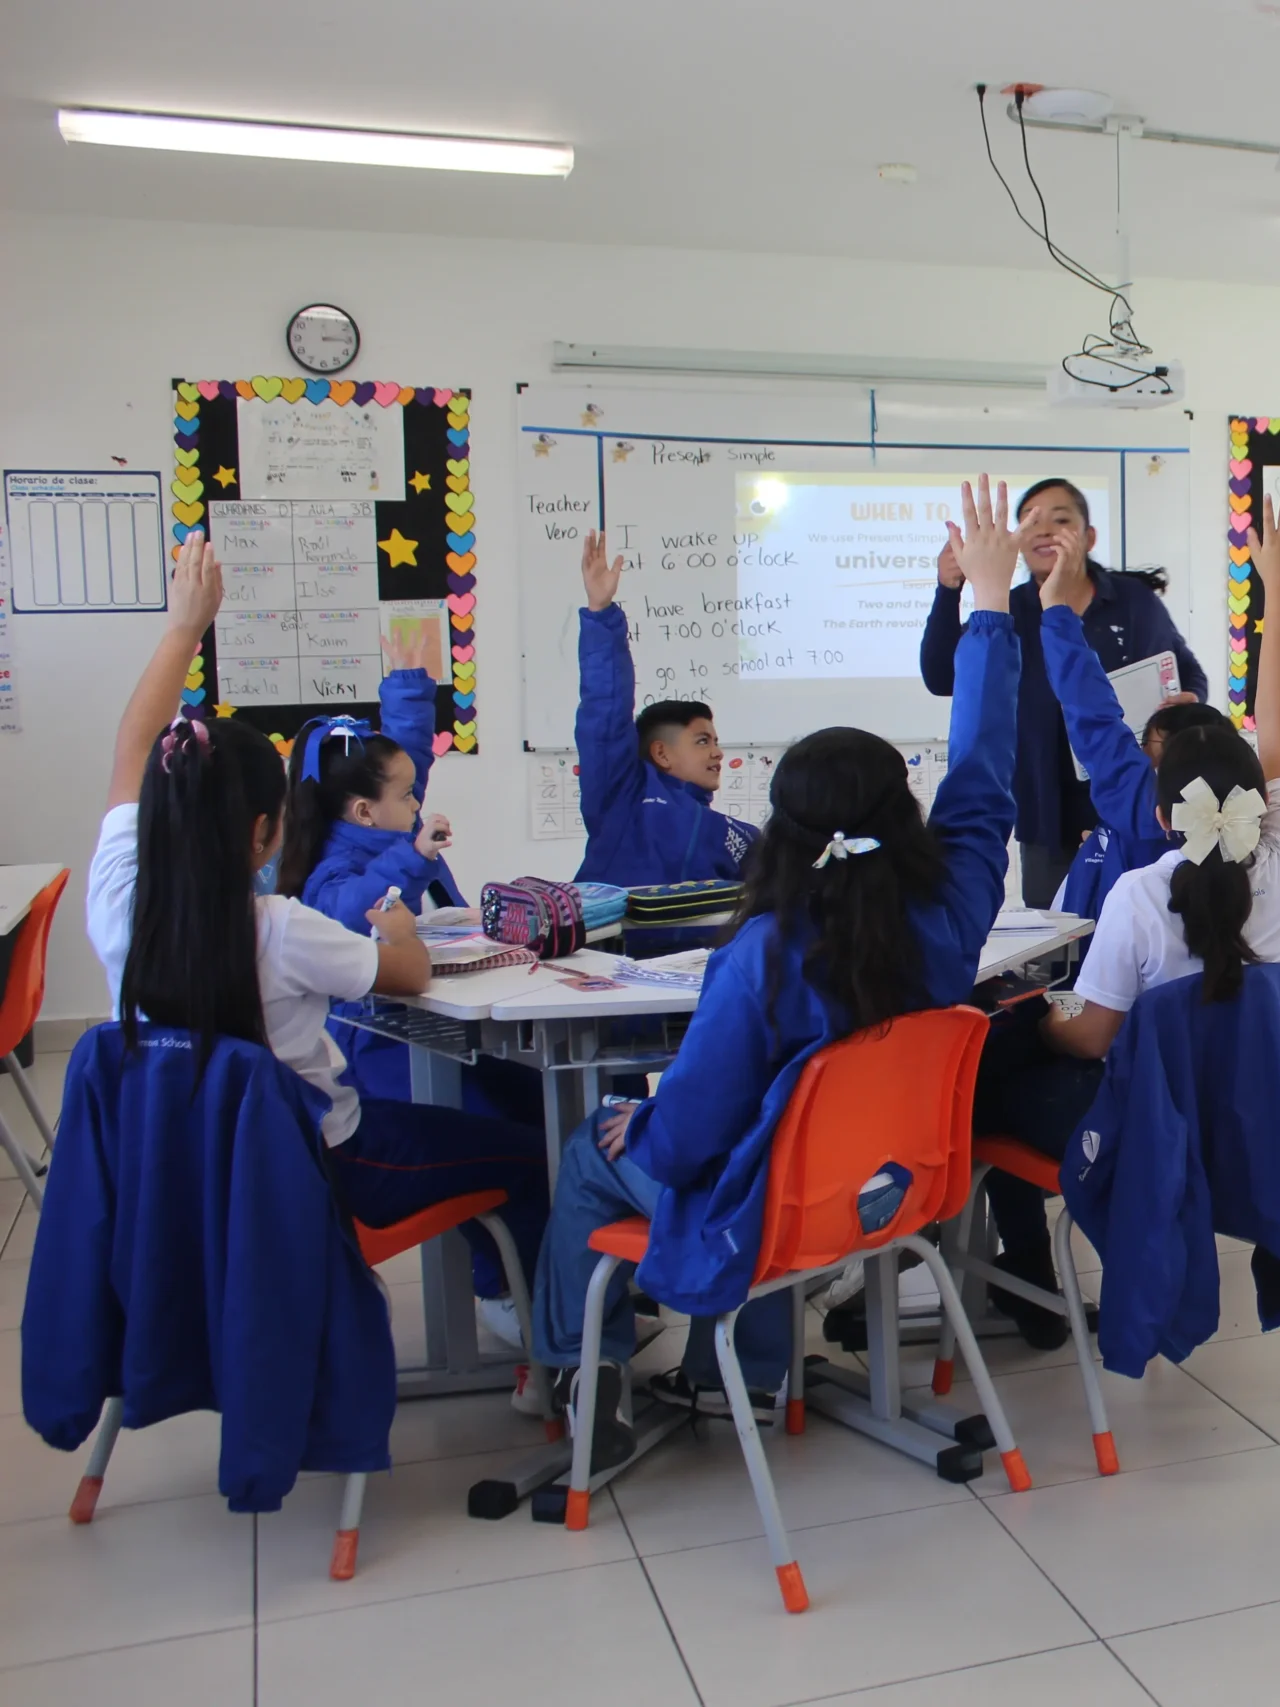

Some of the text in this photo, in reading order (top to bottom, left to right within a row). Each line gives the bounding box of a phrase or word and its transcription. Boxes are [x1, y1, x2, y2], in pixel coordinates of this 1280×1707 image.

[651, 443, 776, 466] Present Simple
[9, 476, 98, 485] Horario de clase:
[308, 502, 335, 516] AULA
[526, 494, 592, 515] Teacher
[850, 502, 951, 521] WHEN TO
[545, 523, 579, 541] Vero
[616, 525, 760, 550] I wake up
[808, 533, 828, 543] We
[832, 534, 854, 543] use
[857, 533, 904, 543] Present
[223, 535, 259, 551] Max
[620, 549, 800, 571] at 6:00 o'clock
[645, 595, 684, 618] have
[702, 592, 792, 614] breakfast
[858, 600, 883, 610] Two
[886, 600, 911, 609] and
[659, 622, 702, 642] 7:00
[823, 619, 846, 629] The
[848, 619, 883, 629] Earth
[656, 667, 676, 690] go
[690, 659, 708, 677] to
[722, 653, 769, 676] school
[775, 649, 795, 667] at
[807, 650, 844, 665] 7:00
[542, 813, 557, 827] A
[729, 804, 742, 818] D
